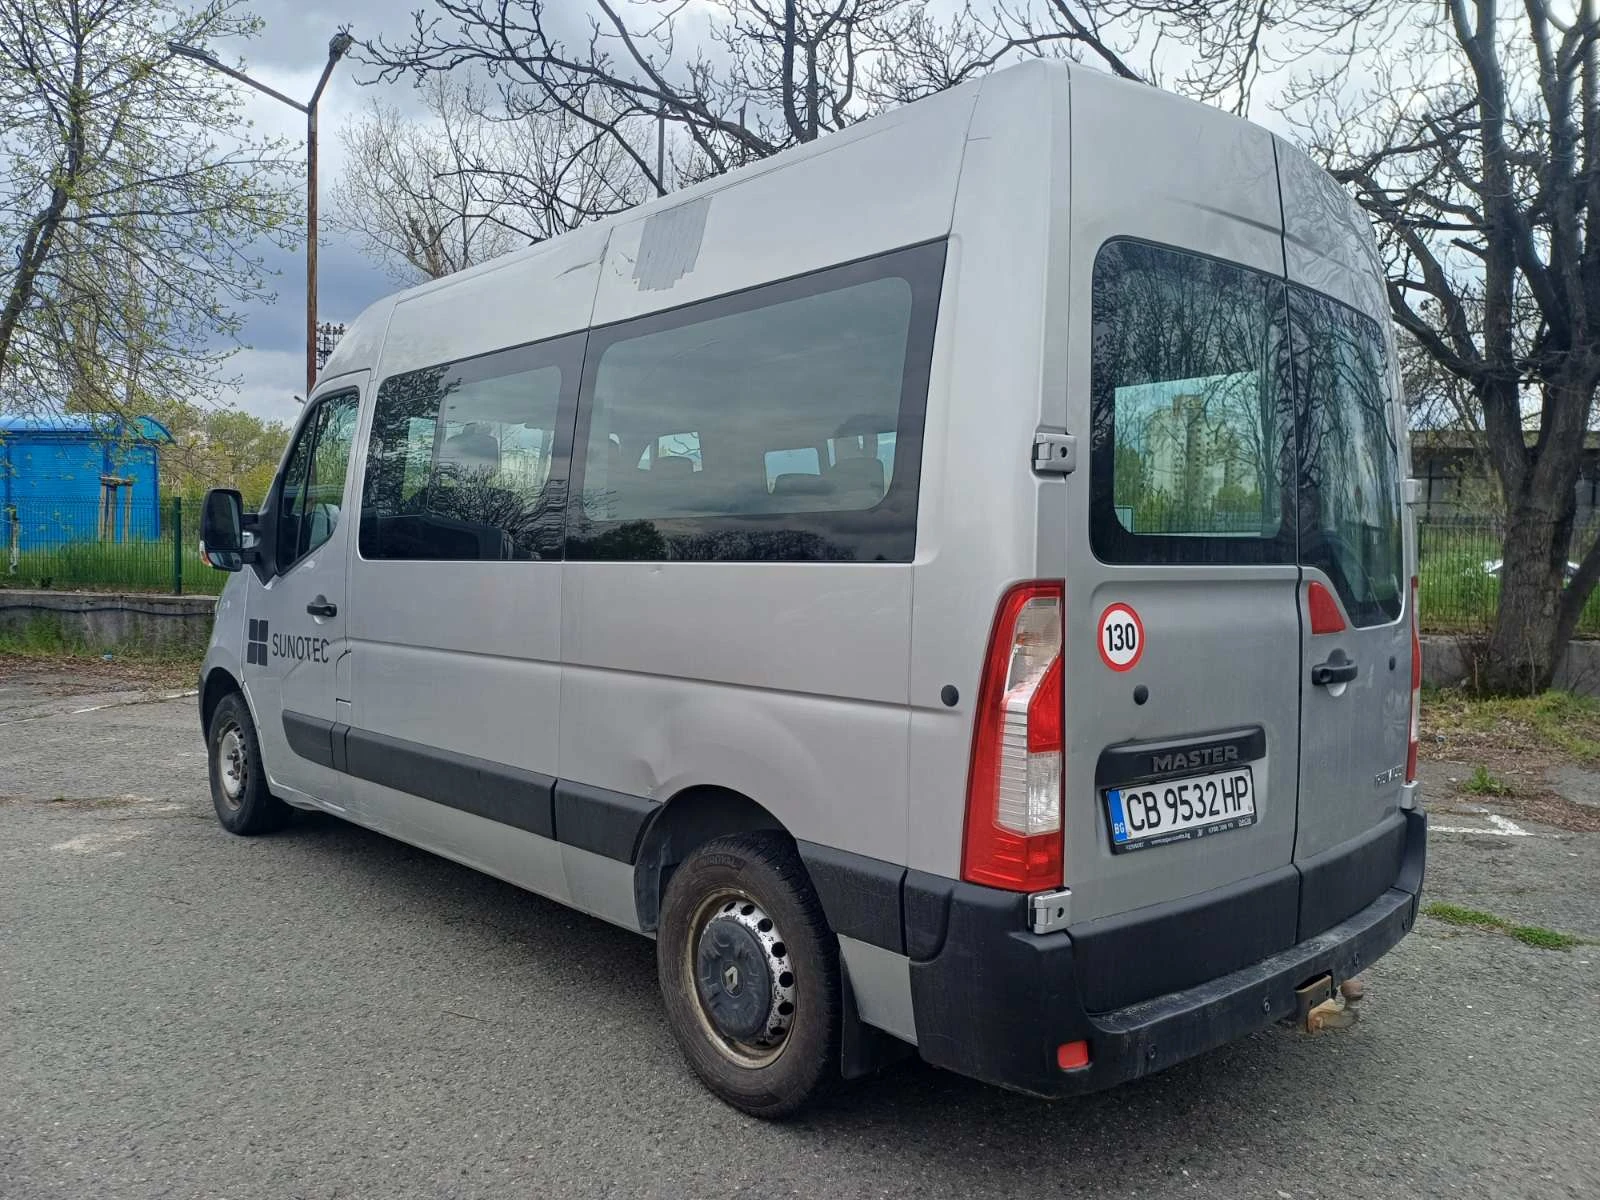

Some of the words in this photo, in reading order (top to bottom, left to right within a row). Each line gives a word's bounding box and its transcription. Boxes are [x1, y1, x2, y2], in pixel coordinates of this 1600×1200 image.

[272, 632, 330, 663] SUNOTEC
[1105, 622, 1136, 652] 130
[1152, 746, 1239, 773] MASTER
[1126, 791, 1162, 831] CB
[1164, 781, 1220, 825] 9532
[1221, 775, 1249, 814] HP
[1114, 822, 1125, 834] BG
